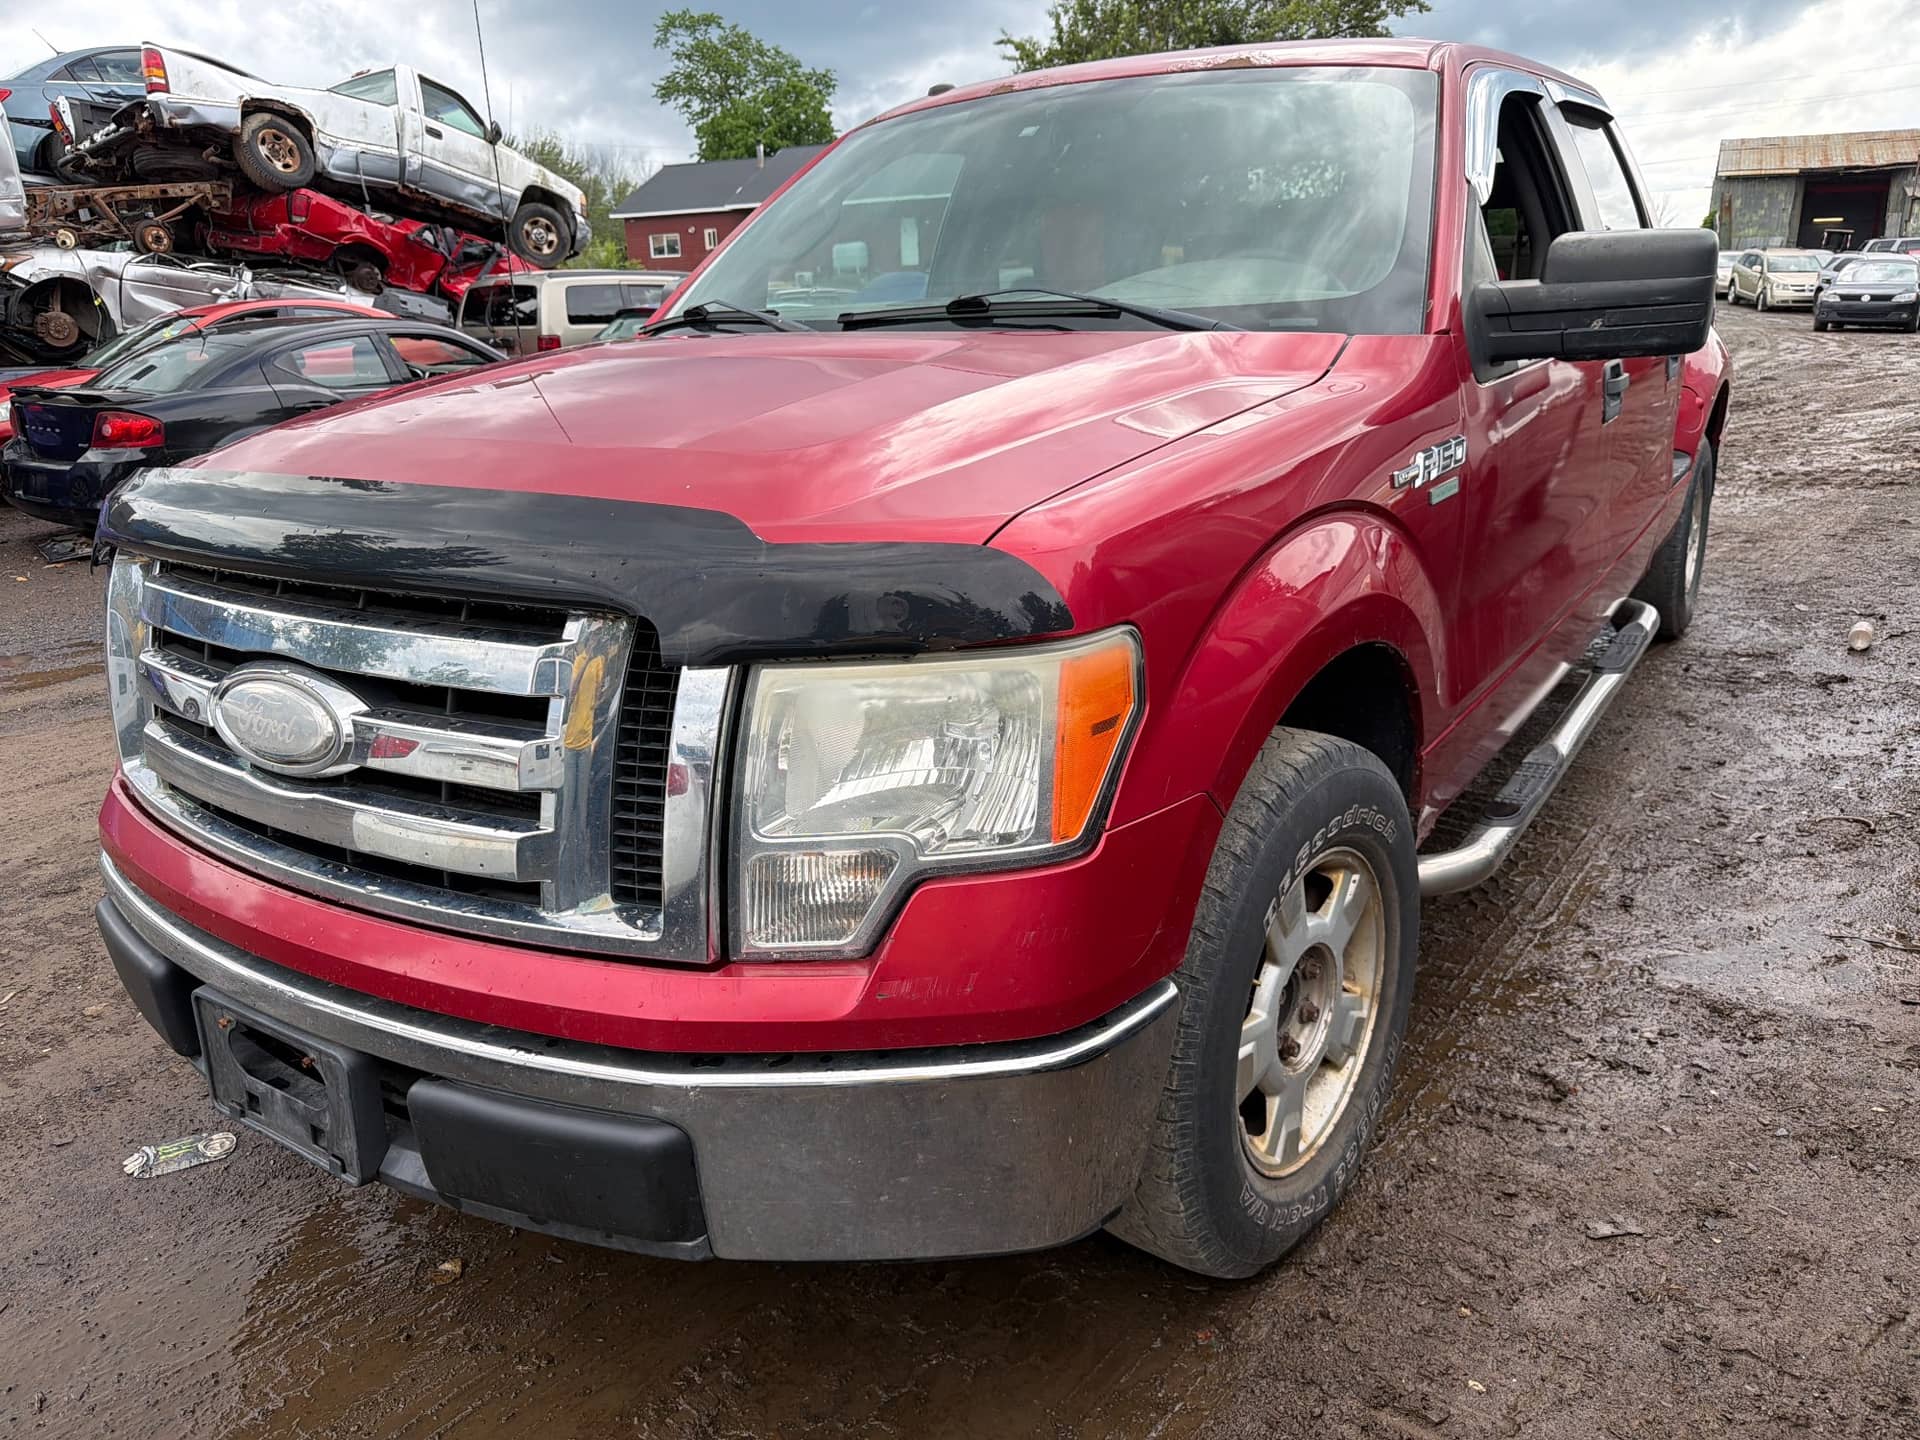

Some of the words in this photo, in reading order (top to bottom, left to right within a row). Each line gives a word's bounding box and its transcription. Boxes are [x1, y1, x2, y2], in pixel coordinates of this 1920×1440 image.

[230, 693, 298, 744] Ford
[1239, 1182, 1270, 1226] T/A
[1268, 1185, 1330, 1232] Trail
